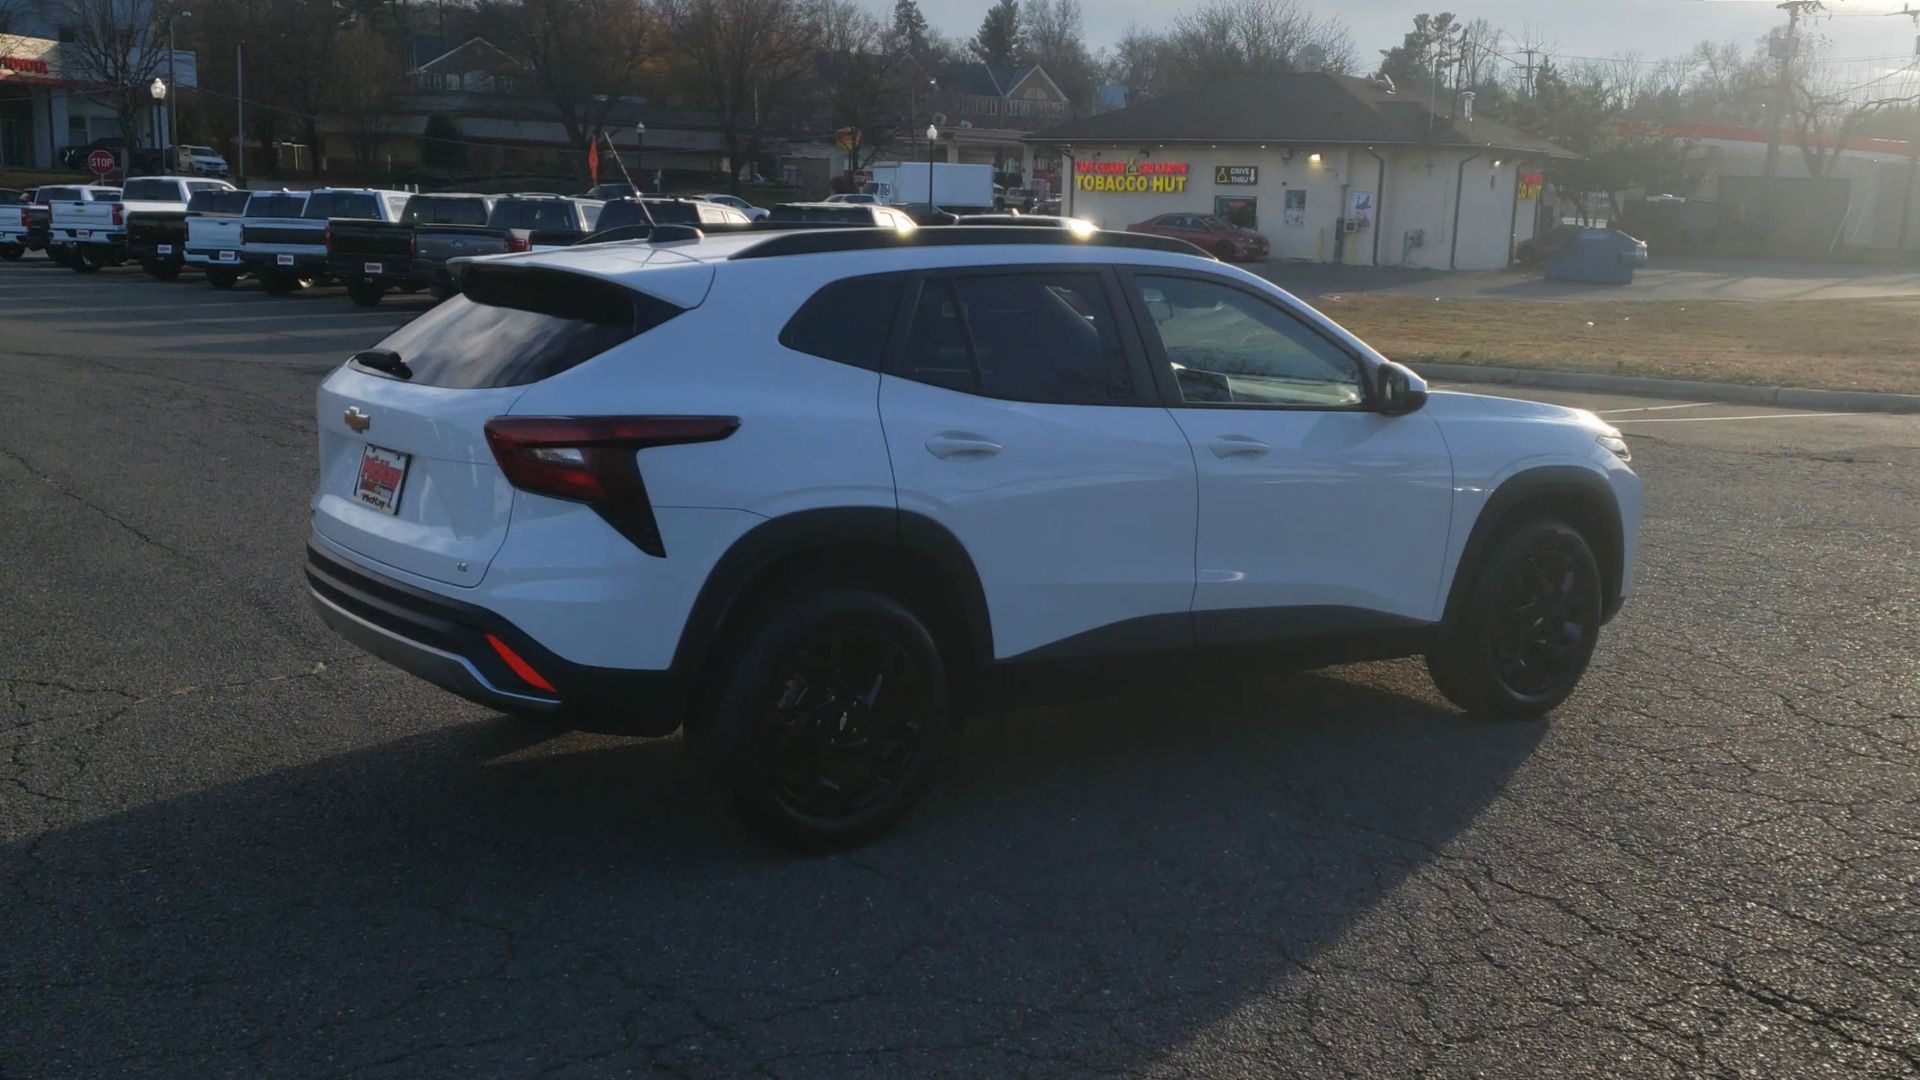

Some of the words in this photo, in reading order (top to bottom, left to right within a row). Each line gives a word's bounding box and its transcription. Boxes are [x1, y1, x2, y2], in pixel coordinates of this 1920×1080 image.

[91, 158, 112, 167] STOP
[1230, 167, 1250, 175] DRIVE
[1231, 175, 1249, 183] THRU
[1075, 175, 1148, 192] TOBACCO
[1152, 176, 1186, 192] HUT
